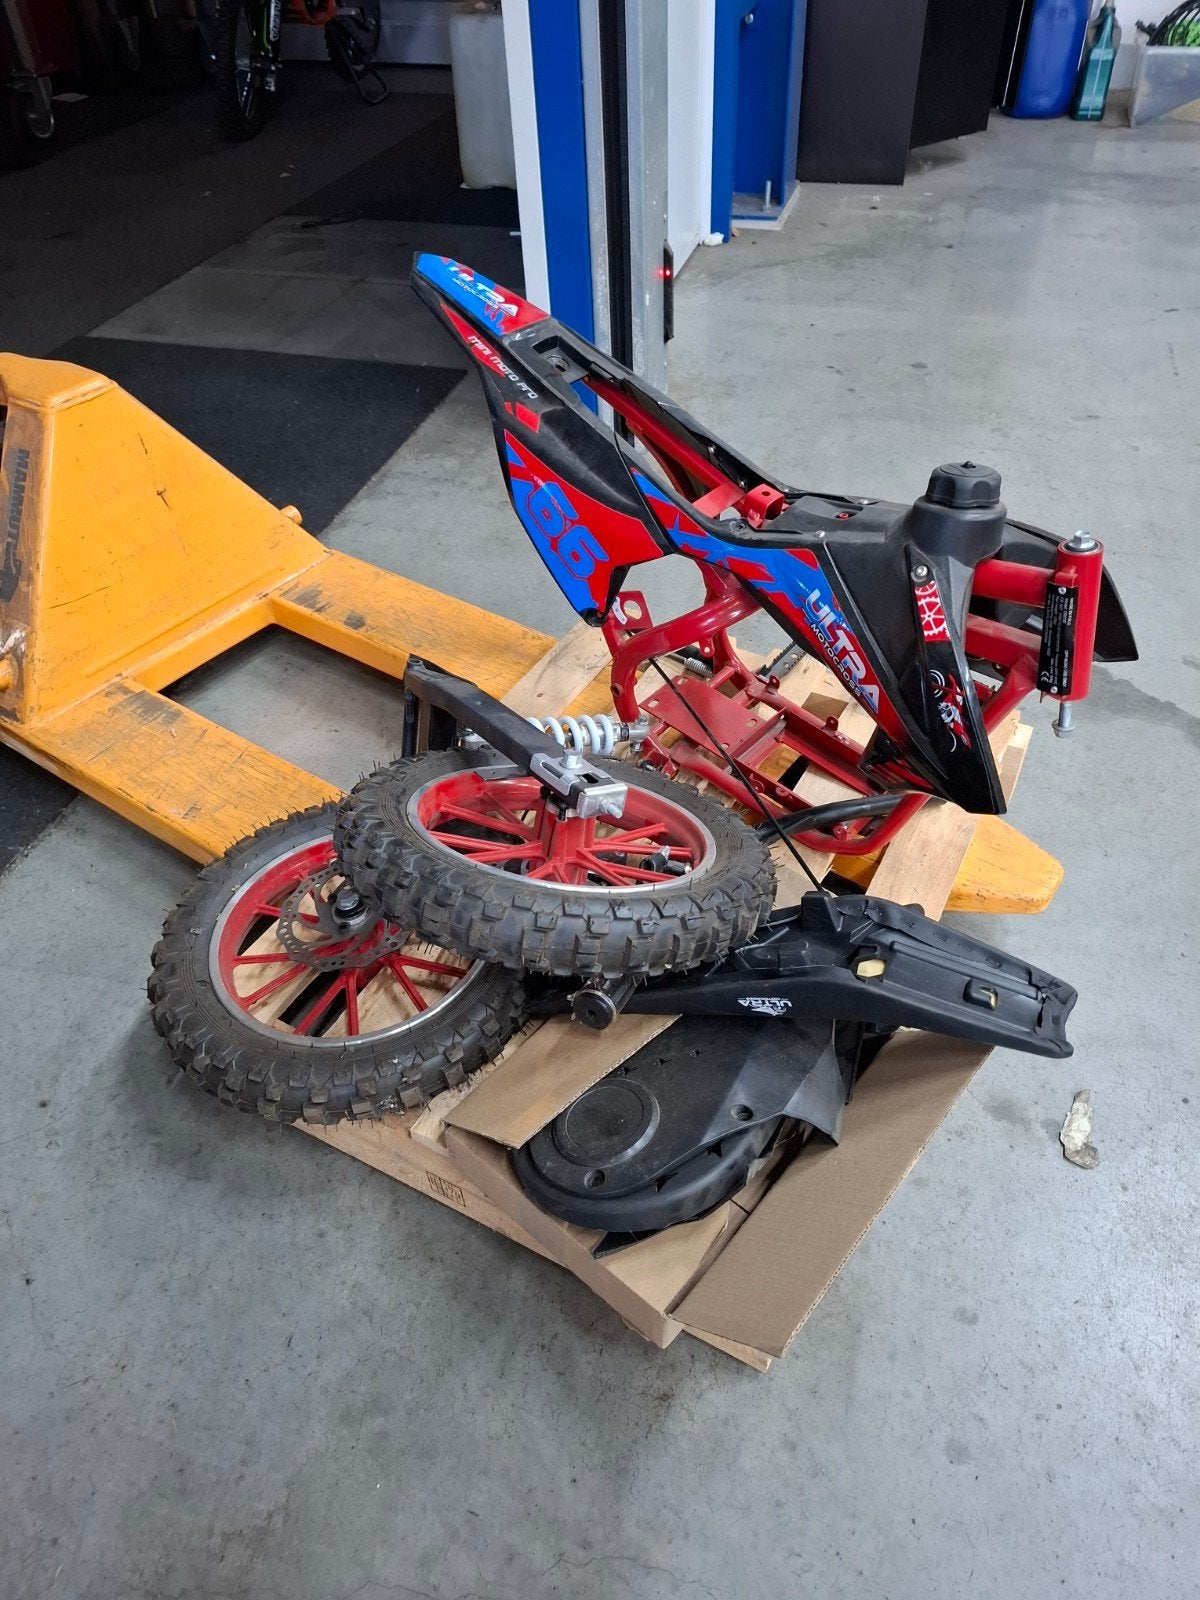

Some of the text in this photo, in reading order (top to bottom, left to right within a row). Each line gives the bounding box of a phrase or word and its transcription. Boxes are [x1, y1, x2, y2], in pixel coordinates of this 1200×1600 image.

[447, 266, 518, 316] ULTRA
[527, 481, 609, 578] 66
[806, 588, 880, 714] ULTRA
[810, 623, 862, 697] MOTOCROSS
